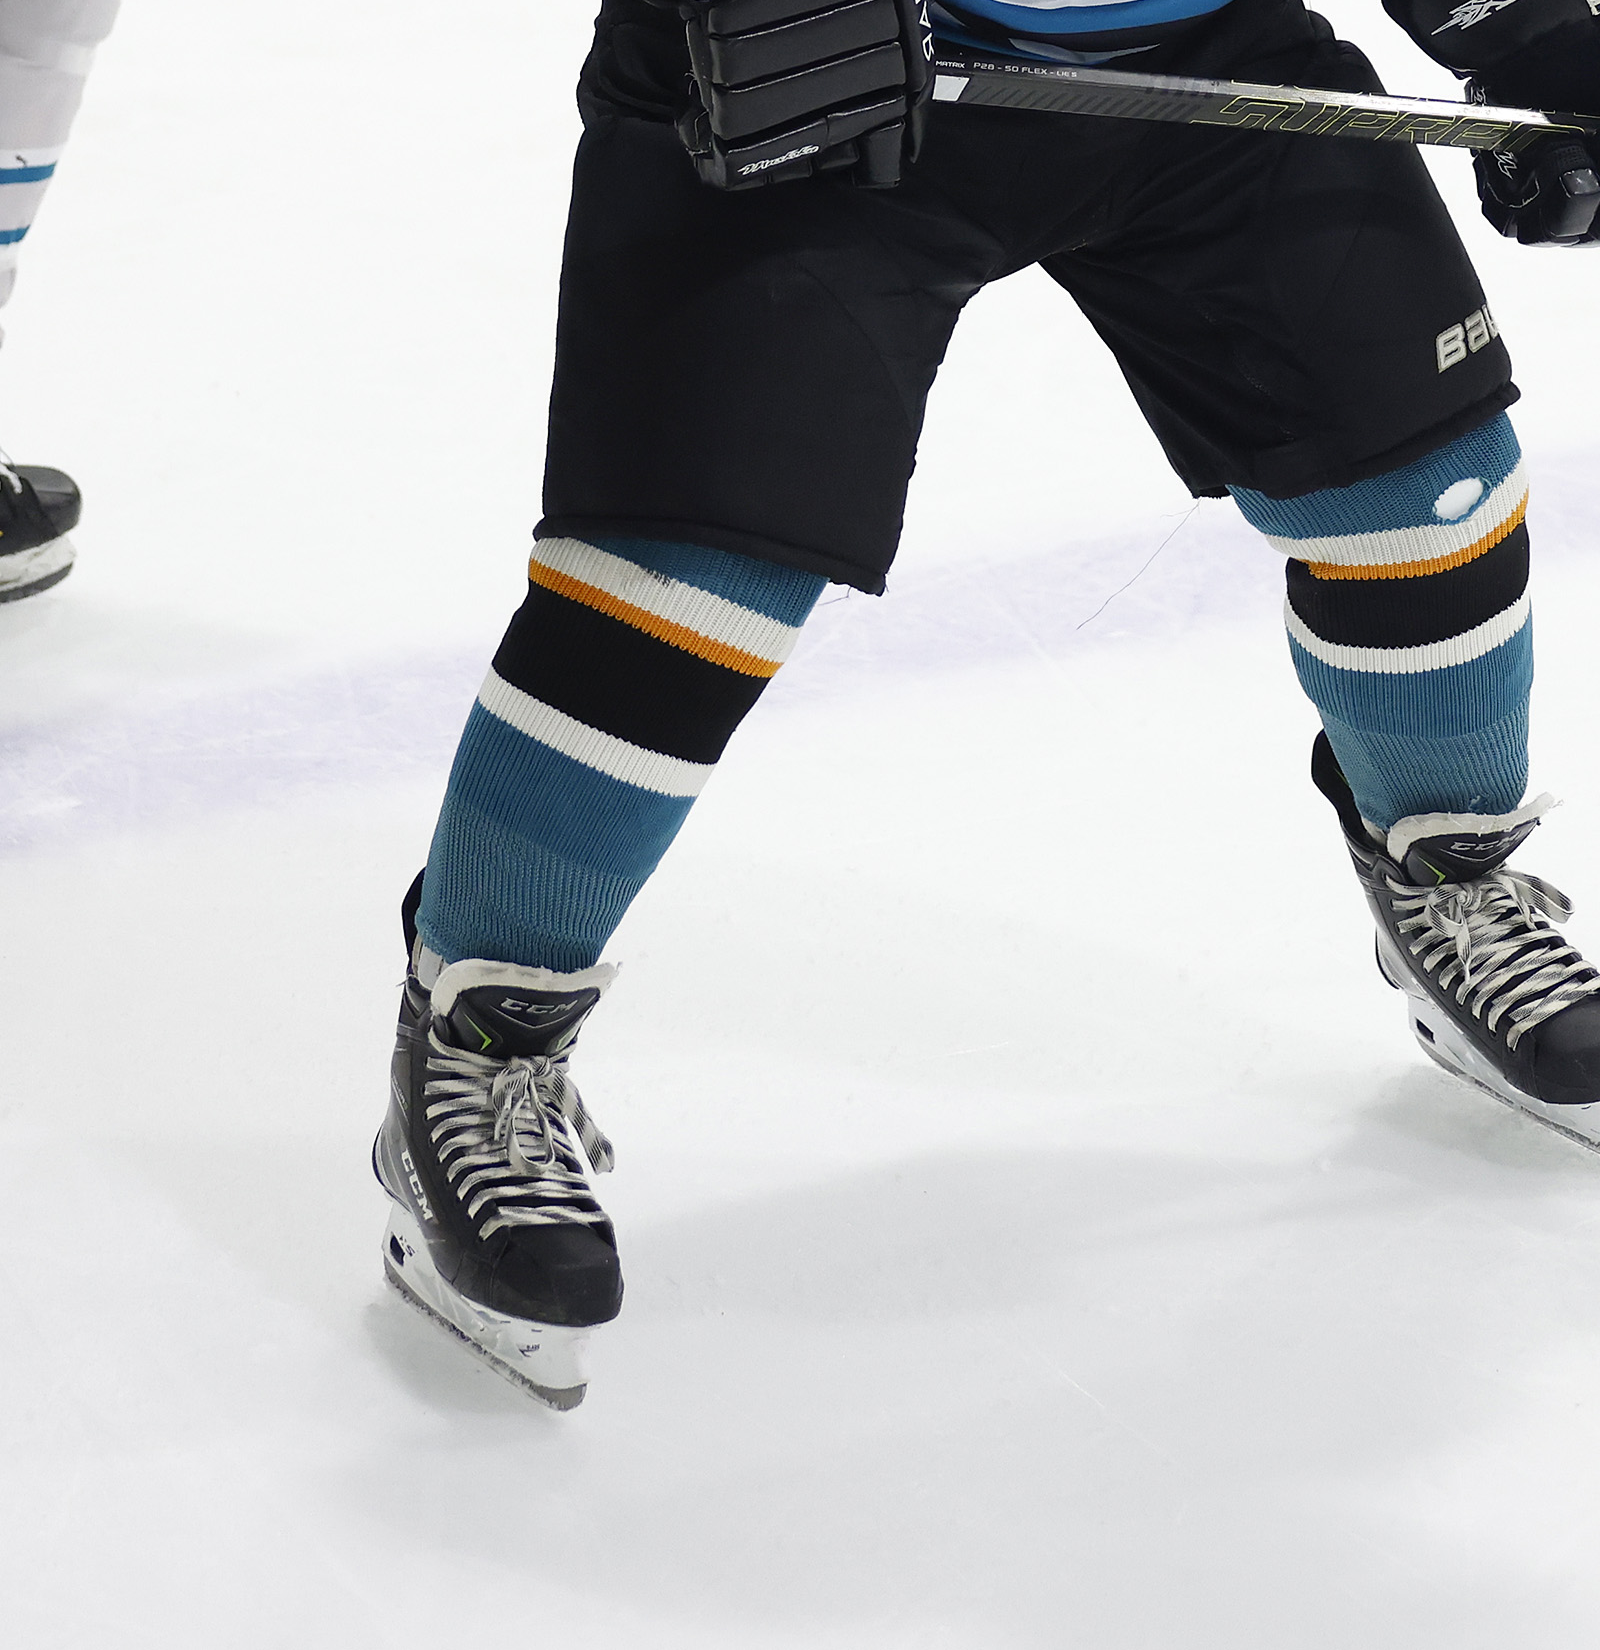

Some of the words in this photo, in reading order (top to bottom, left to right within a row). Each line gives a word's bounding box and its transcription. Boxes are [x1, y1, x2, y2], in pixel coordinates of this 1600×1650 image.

[935, 60, 966, 69] MATRIX
[1021, 66, 1048, 75] FLEX
[1190, 94, 1588, 150] SUPRE
[499, 996, 578, 1017] CCM
[401, 1149, 435, 1222] CCM
